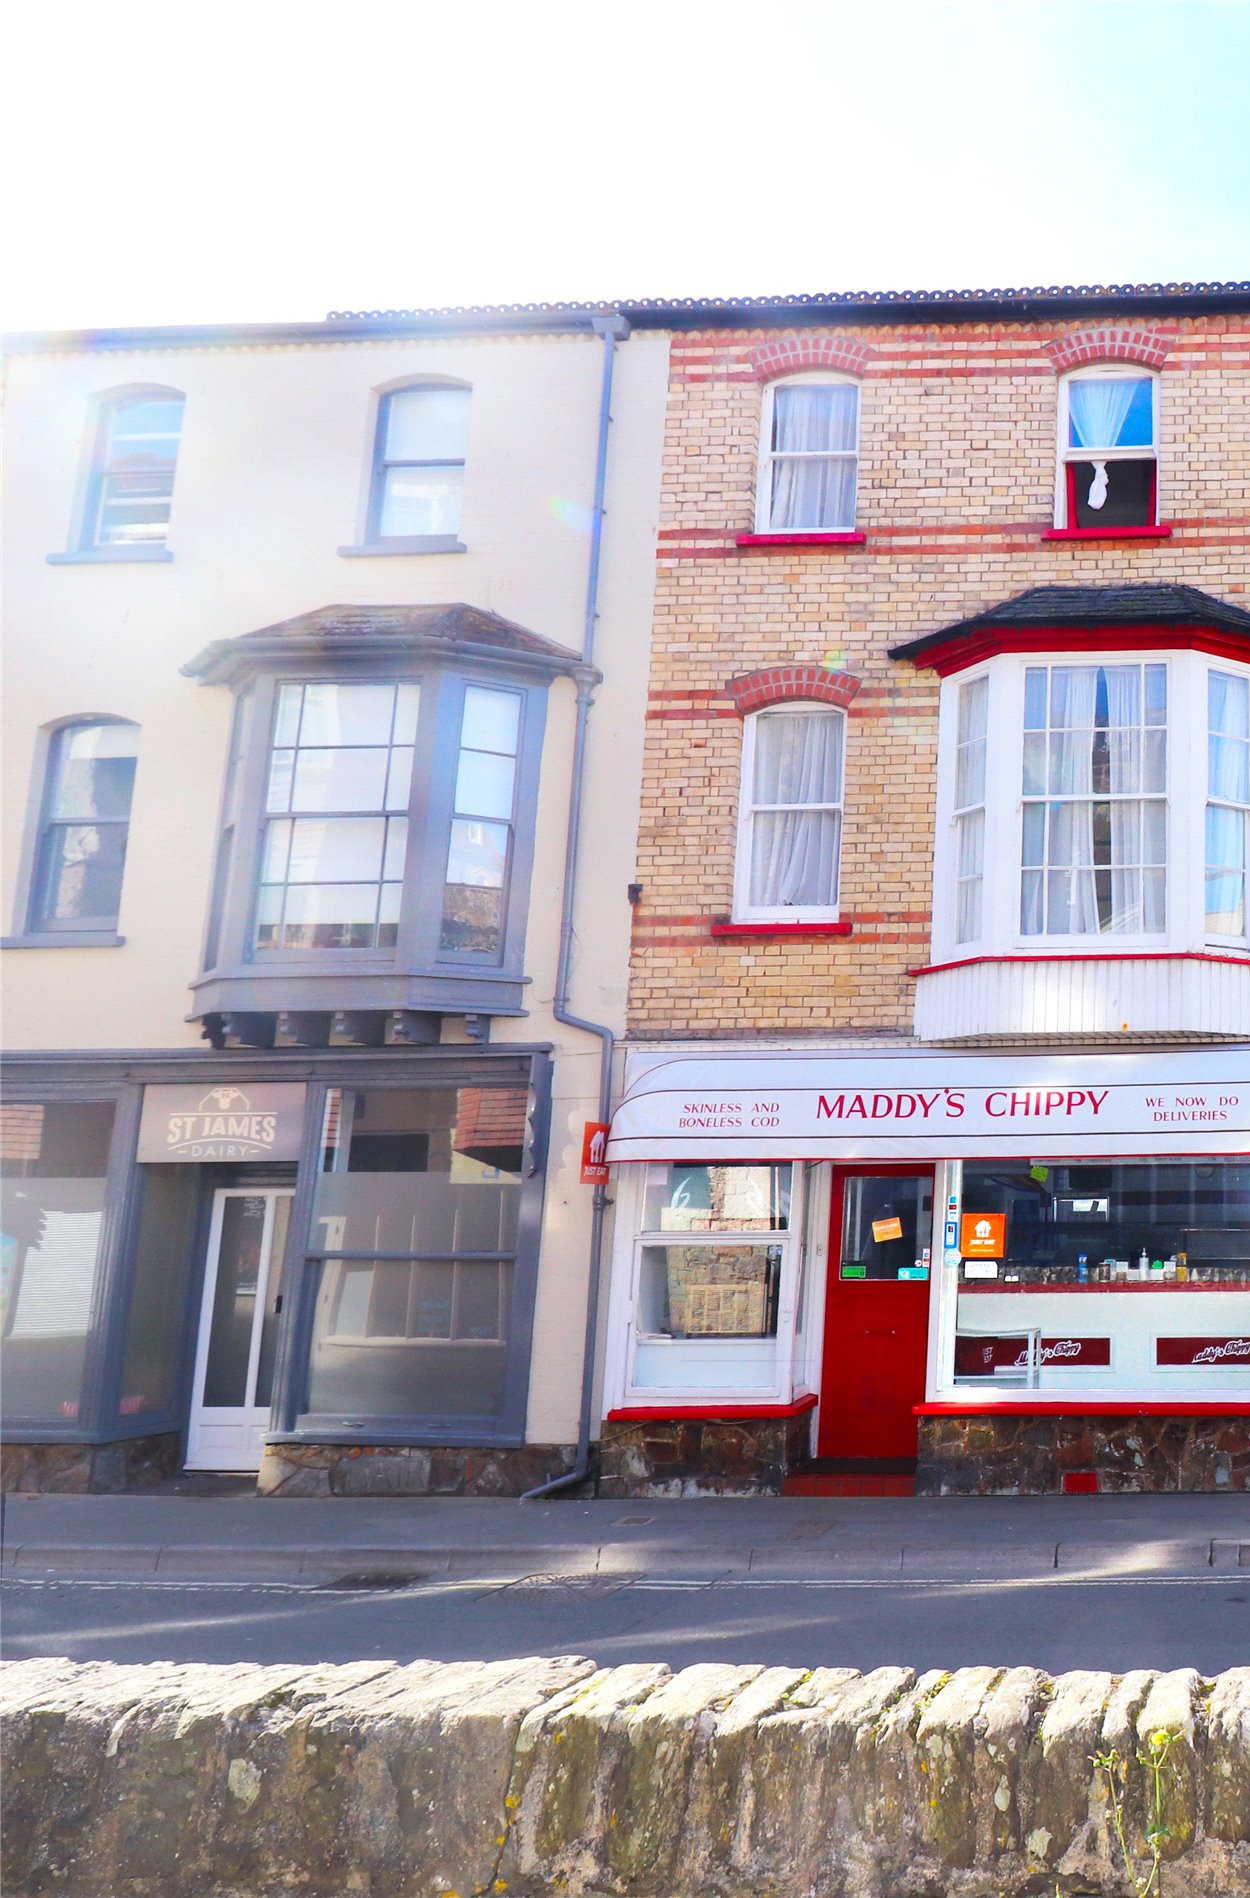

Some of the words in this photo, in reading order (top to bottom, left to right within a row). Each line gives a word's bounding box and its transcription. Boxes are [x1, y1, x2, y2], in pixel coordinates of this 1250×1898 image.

[816, 1088, 966, 1119] MADDY'S
[985, 1091, 1110, 1117] CHIPPY
[1145, 1097, 1165, 1107] WE
[1175, 1096, 1207, 1106] NOW
[1219, 1096, 1239, 1106] DO
[683, 1103, 742, 1114] SKINLESS
[751, 1102, 780, 1113] AND
[1153, 1110, 1228, 1121] DELIVERIES
[679, 1117, 742, 1128] BONELESS
[751, 1116, 780, 1127] COD
[167, 1116, 197, 1144] ST
[201, 1116, 276, 1142] JAMES
[191, 1145, 250, 1157] DAIRY
[584, 1166, 597, 1176] JUST
[597, 1166, 607, 1176] EAT
